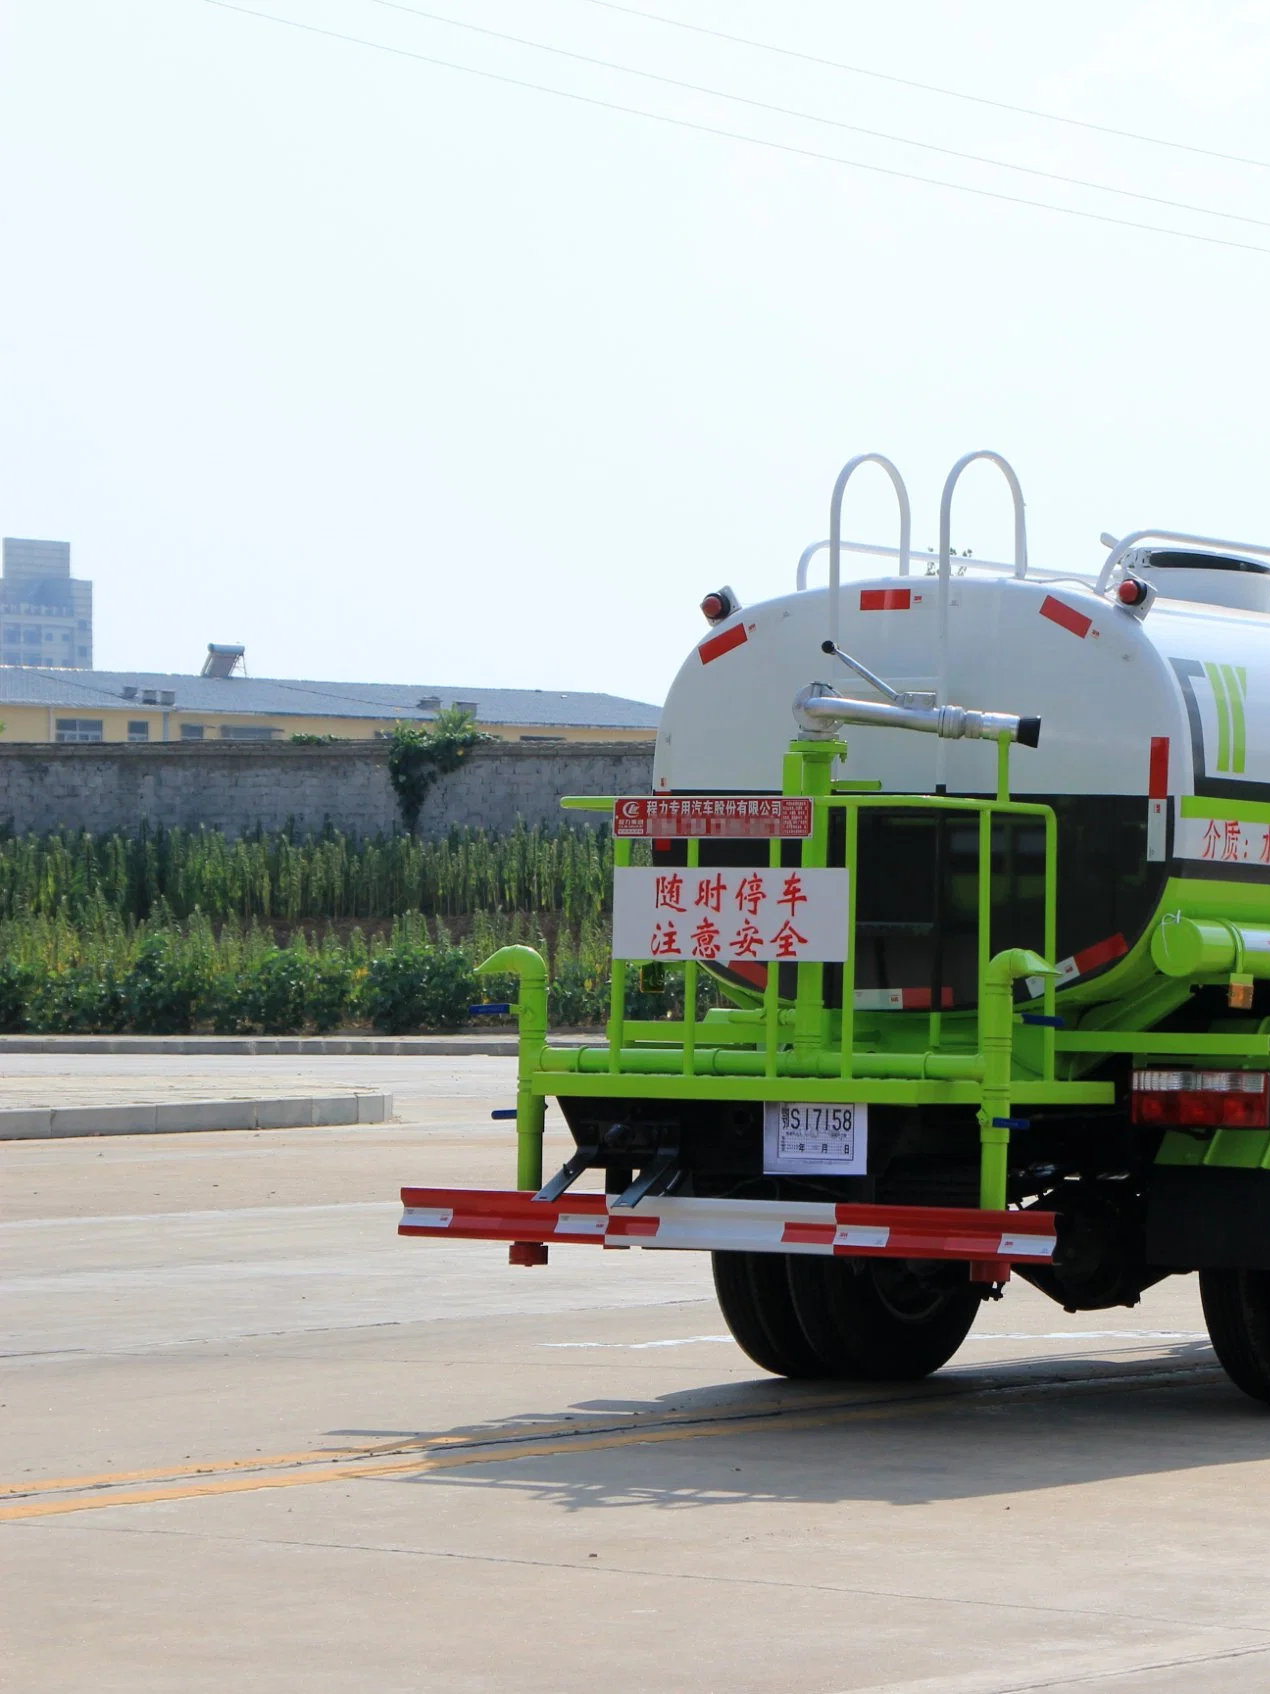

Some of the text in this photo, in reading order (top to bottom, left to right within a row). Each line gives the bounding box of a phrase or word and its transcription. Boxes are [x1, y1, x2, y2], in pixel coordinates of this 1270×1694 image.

[646, 800, 782, 816] 程力专用汽车股份有限公司
[655, 872, 808, 917] 随时停车
[650, 916, 809, 959] 注意安全
